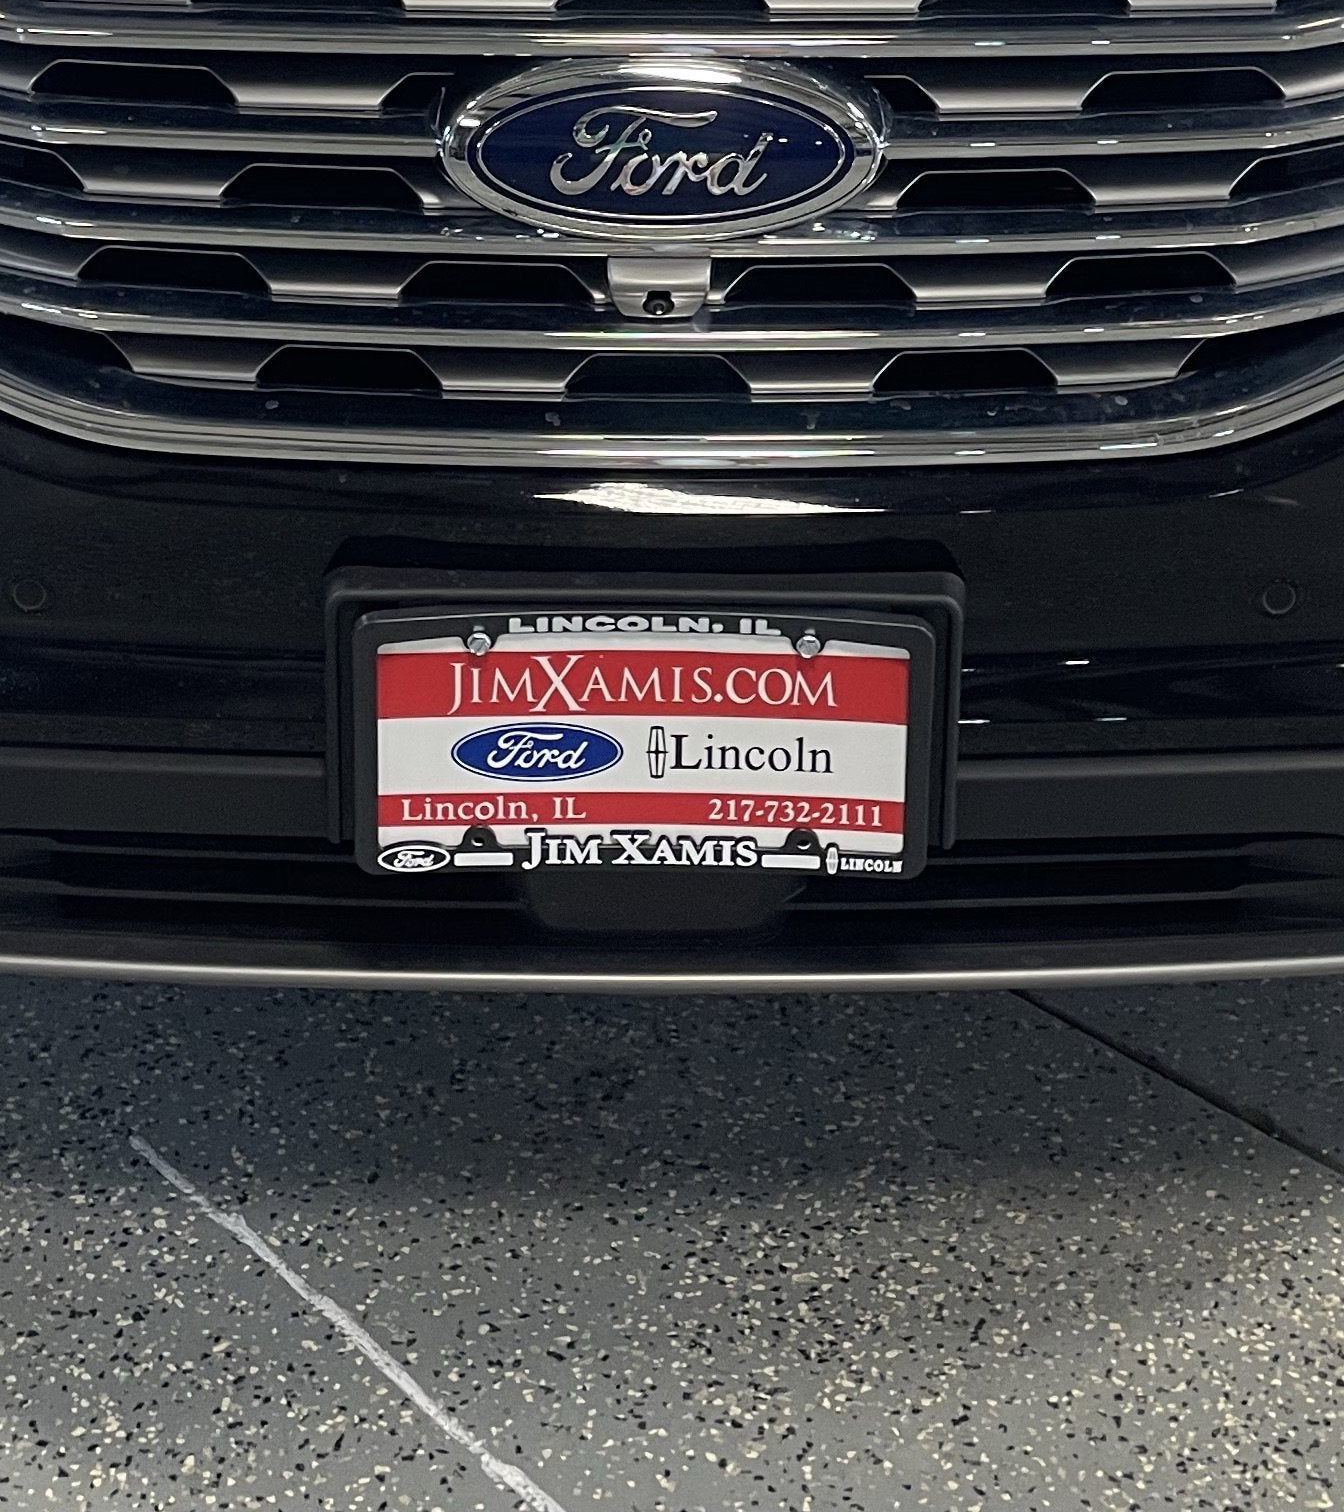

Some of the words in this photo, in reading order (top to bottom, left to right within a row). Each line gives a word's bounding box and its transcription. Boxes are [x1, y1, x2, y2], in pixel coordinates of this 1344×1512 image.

[550, 106, 771, 195] Ford
[739, 618, 781, 636] IL
[487, 731, 586, 770] Ford
[670, 734, 832, 773] Lincoln
[402, 797, 538, 823] Lincoln,
[552, 797, 586, 819] IL
[708, 798, 882, 826] 217-732-2111
[394, 850, 435, 868] Ford
[522, 832, 600, 870] JIM
[611, 834, 758, 867] XAMIS
[840, 857, 902, 872] LINCOLN
